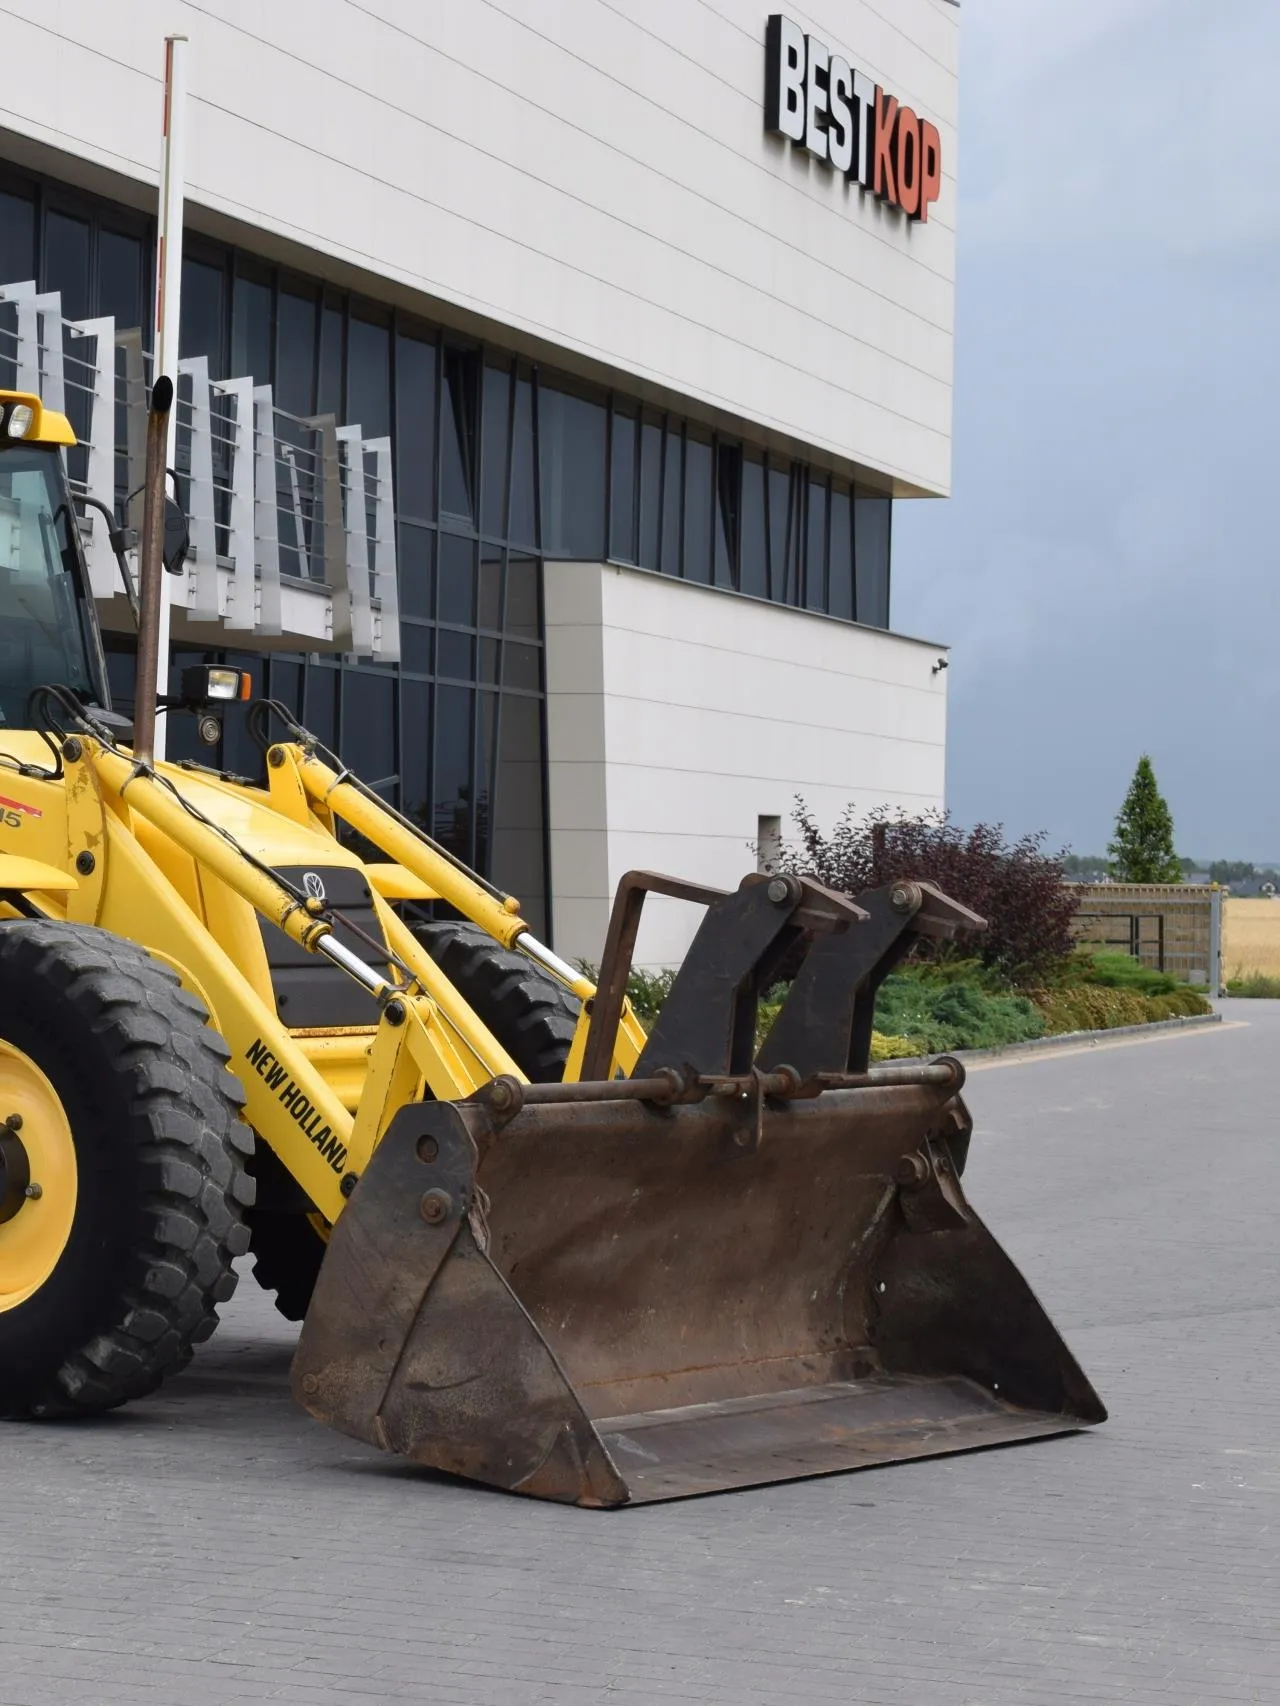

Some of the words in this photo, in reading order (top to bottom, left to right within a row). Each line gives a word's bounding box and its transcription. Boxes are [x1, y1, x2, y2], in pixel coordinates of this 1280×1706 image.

[768, 14, 941, 223] BESTKOP
[245, 1038, 288, 1091] NEW
[278, 1081, 348, 1174] HOLLAND
